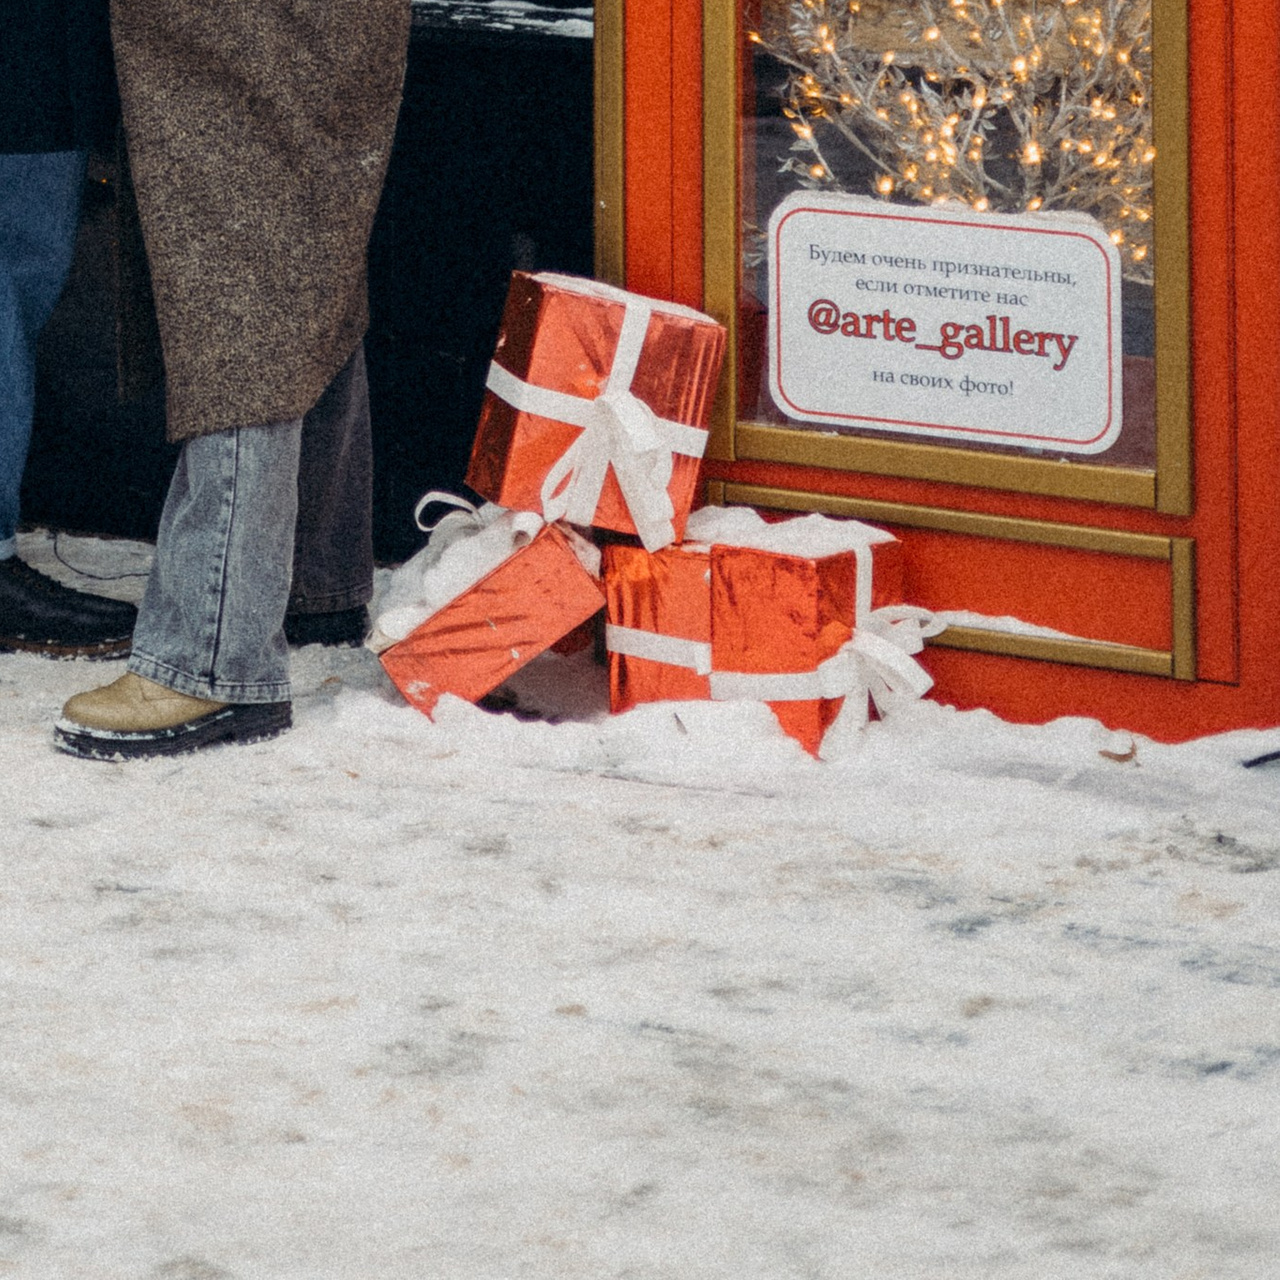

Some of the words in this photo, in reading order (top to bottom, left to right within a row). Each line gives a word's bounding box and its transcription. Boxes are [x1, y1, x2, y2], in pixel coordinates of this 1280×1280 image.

[809, 244, 866, 266] Будем
[871, 254, 927, 270] очень
[932, 260, 1077, 287] признательны,
[855, 278, 898, 293] если
[903, 283, 991, 302] отметите
[996, 292, 1028, 306] нас
[807, 299, 1079, 371] @arte_gallery
[873, 371, 895, 383] на
[900, 373, 953, 389] своих
[959, 375, 1013, 396] фото!
